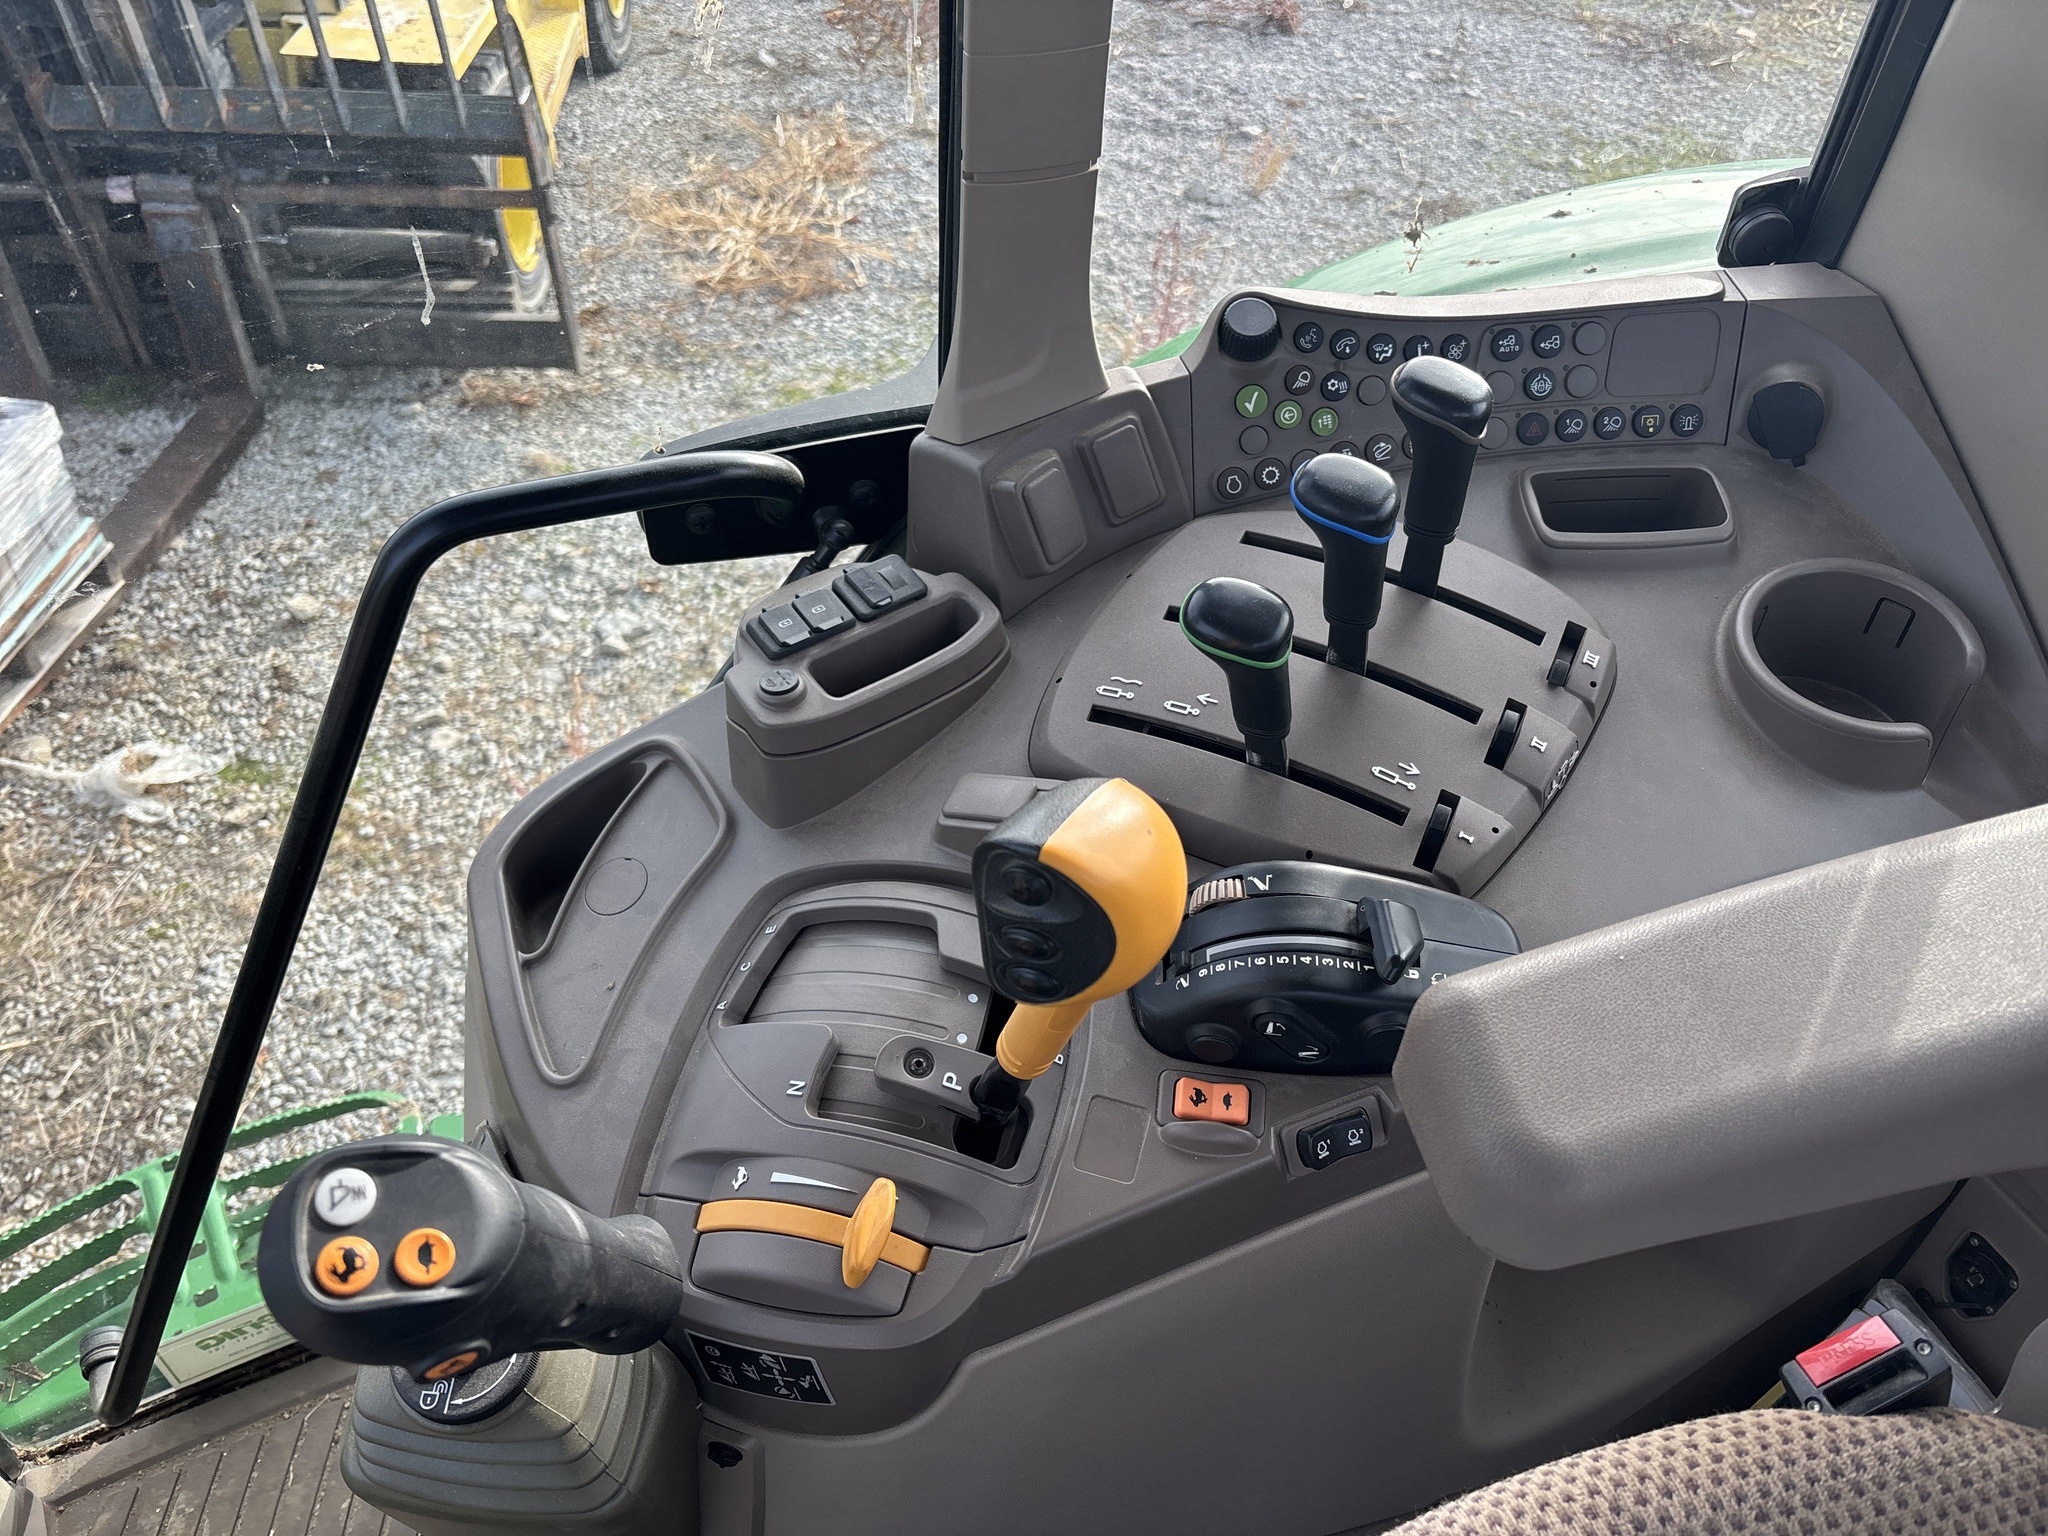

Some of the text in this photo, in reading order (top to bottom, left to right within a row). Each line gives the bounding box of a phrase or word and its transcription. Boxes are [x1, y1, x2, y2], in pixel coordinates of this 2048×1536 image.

[1498, 345, 1520, 353] AUTO
[1565, 418, 1570, 427] 1
[1603, 416, 1609, 425] 2
[1582, 649, 1600, 668] III
[1530, 736, 1547, 752] II
[765, 924, 777, 934] E
[740, 961, 751, 971] C
[1198, 968, 1208, 977] 9
[1215, 963, 1226, 972] 8
[1234, 960, 1245, 968] 7
[1254, 957, 1266, 965] 6
[1276, 956, 1289, 964] 5
[1300, 955, 1312, 964] 4
[1322, 958, 1334, 966] 3
[1342, 961, 1354, 969] 2
[716, 1000, 728, 1010] A
[786, 1080, 806, 1096] N
[942, 1071, 962, 1092] P
[1819, 1332, 1876, 1369] PRESS
